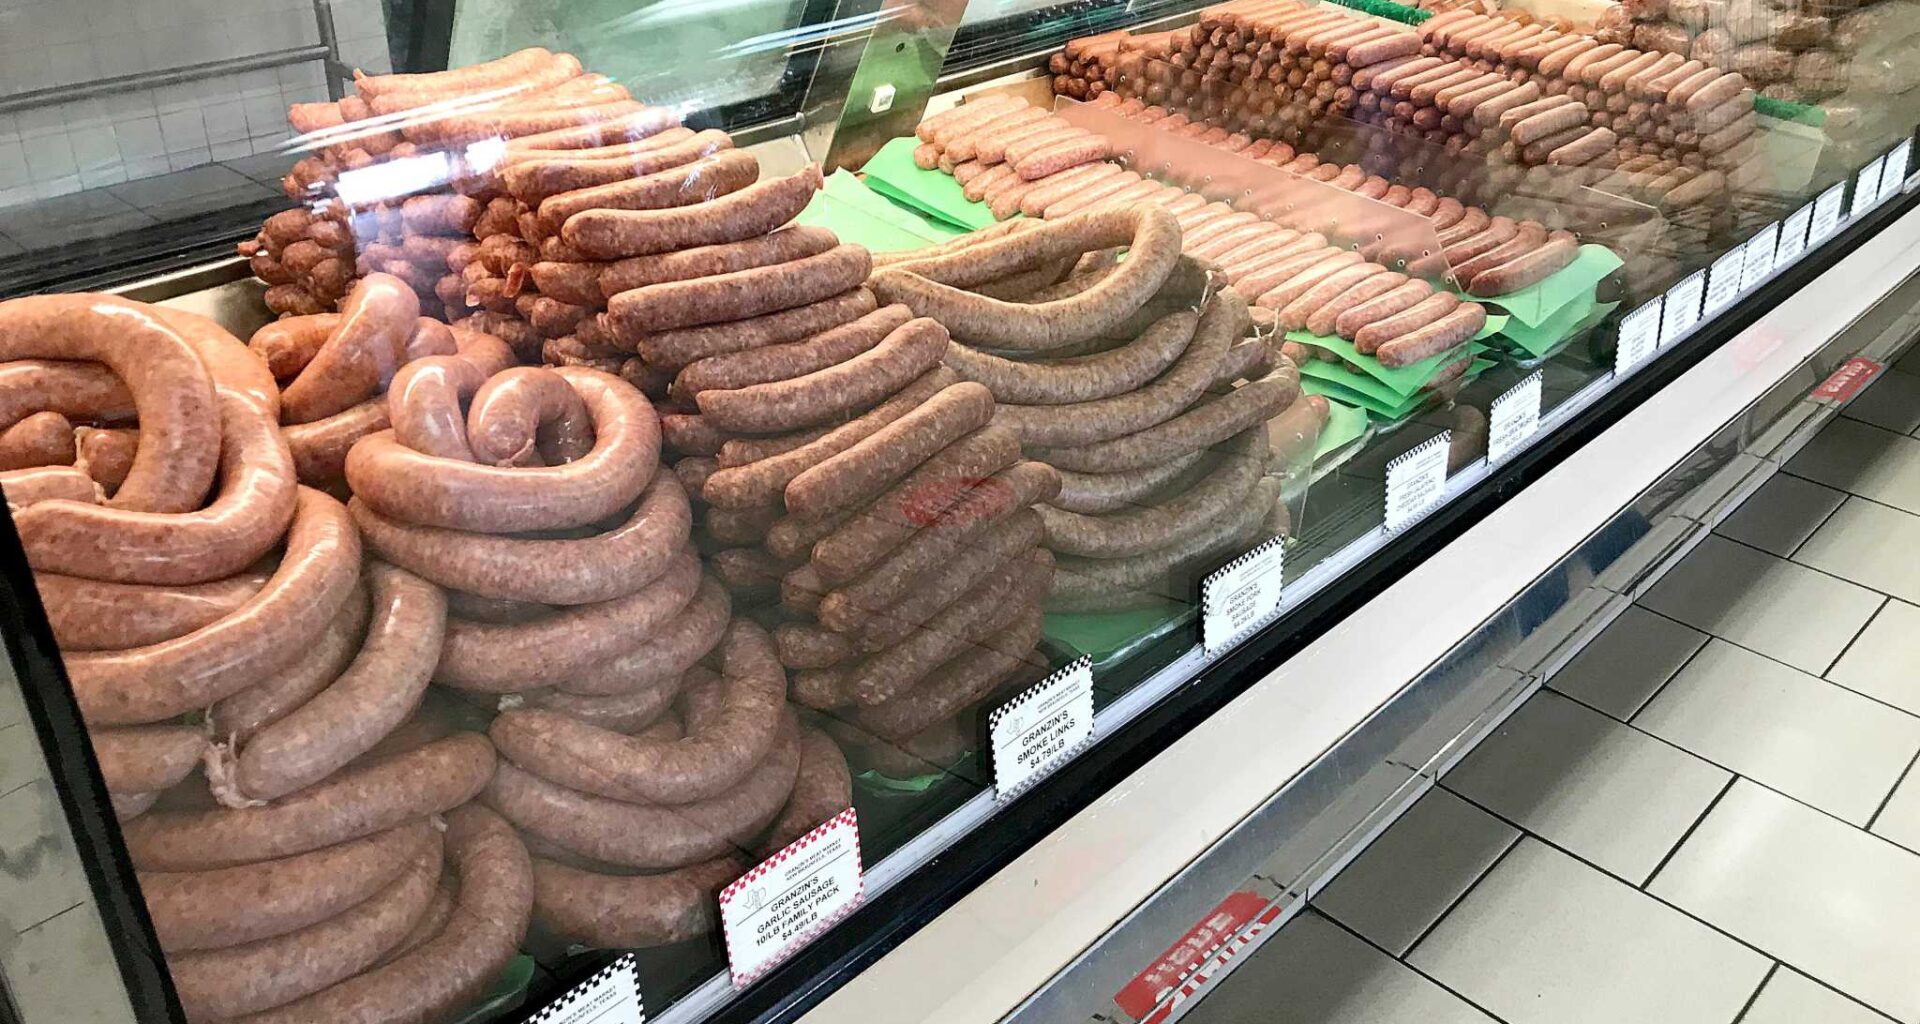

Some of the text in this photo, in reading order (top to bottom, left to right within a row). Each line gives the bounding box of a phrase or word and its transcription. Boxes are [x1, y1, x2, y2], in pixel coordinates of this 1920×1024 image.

[1017, 717, 1075, 765] SMOKE LINKS
[1022, 709, 1068, 747] GRANZIN'S
[1030, 738, 1064, 769] $4.79/LB
[756, 876, 834, 935] GARLIC SAUSAGE
[770, 875, 818, 913] GRANZIN'S
[756, 884, 839, 947] 10/LB FAMILY PACK
[781, 911, 817, 941] $4.49/LB
